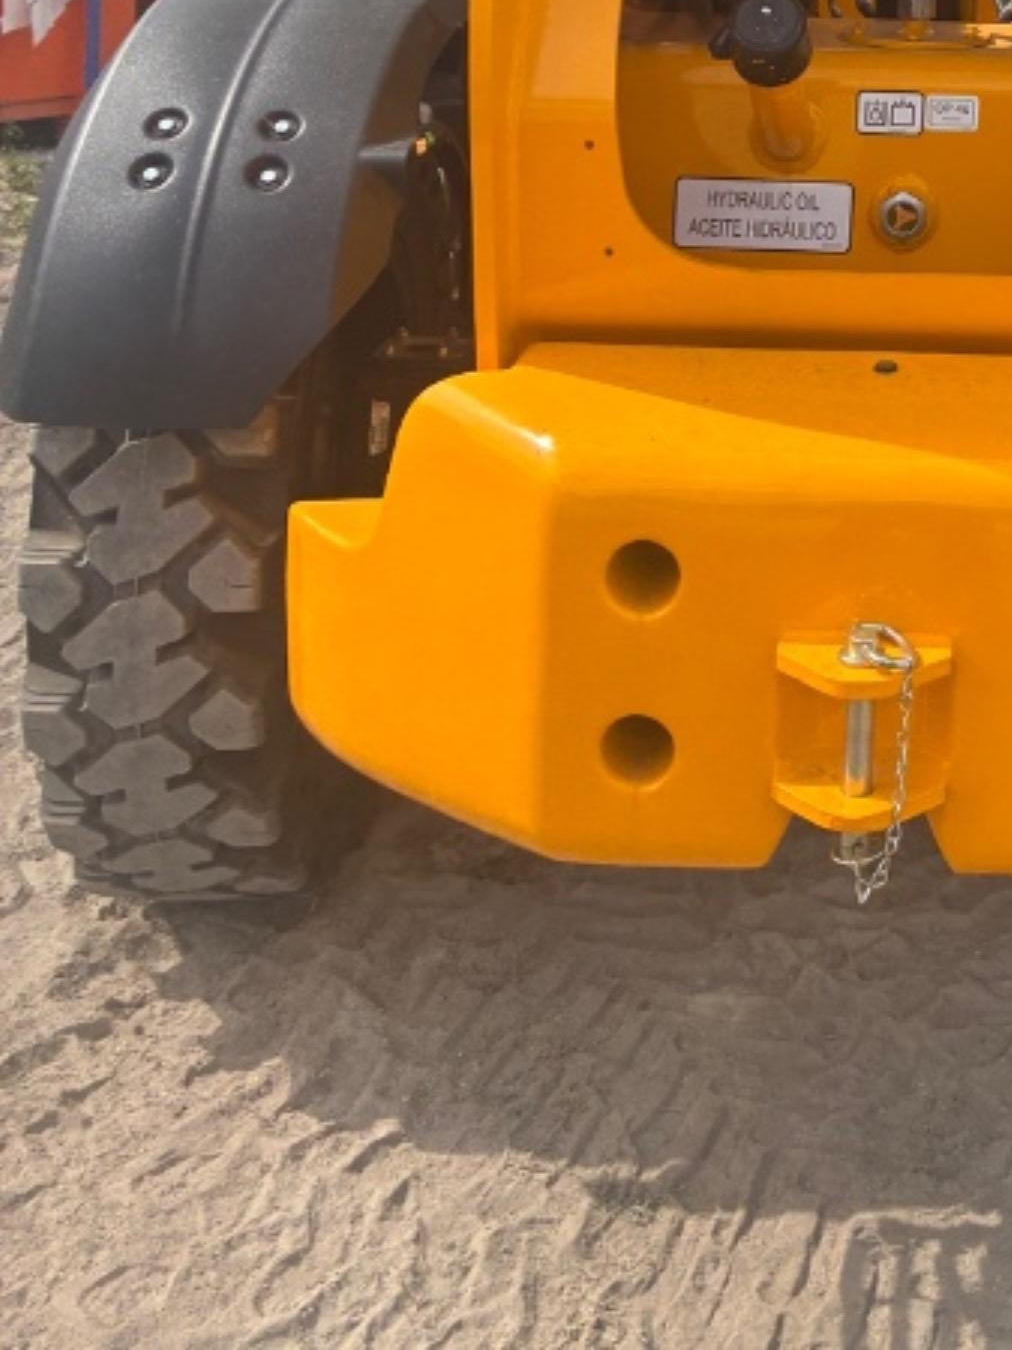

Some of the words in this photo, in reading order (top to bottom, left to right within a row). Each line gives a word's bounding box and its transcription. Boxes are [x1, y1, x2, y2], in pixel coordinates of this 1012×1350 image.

[706, 190, 795, 212] HYDRAULIC
[797, 192, 820, 212] OIL
[687, 218, 742, 239] ACEITE
